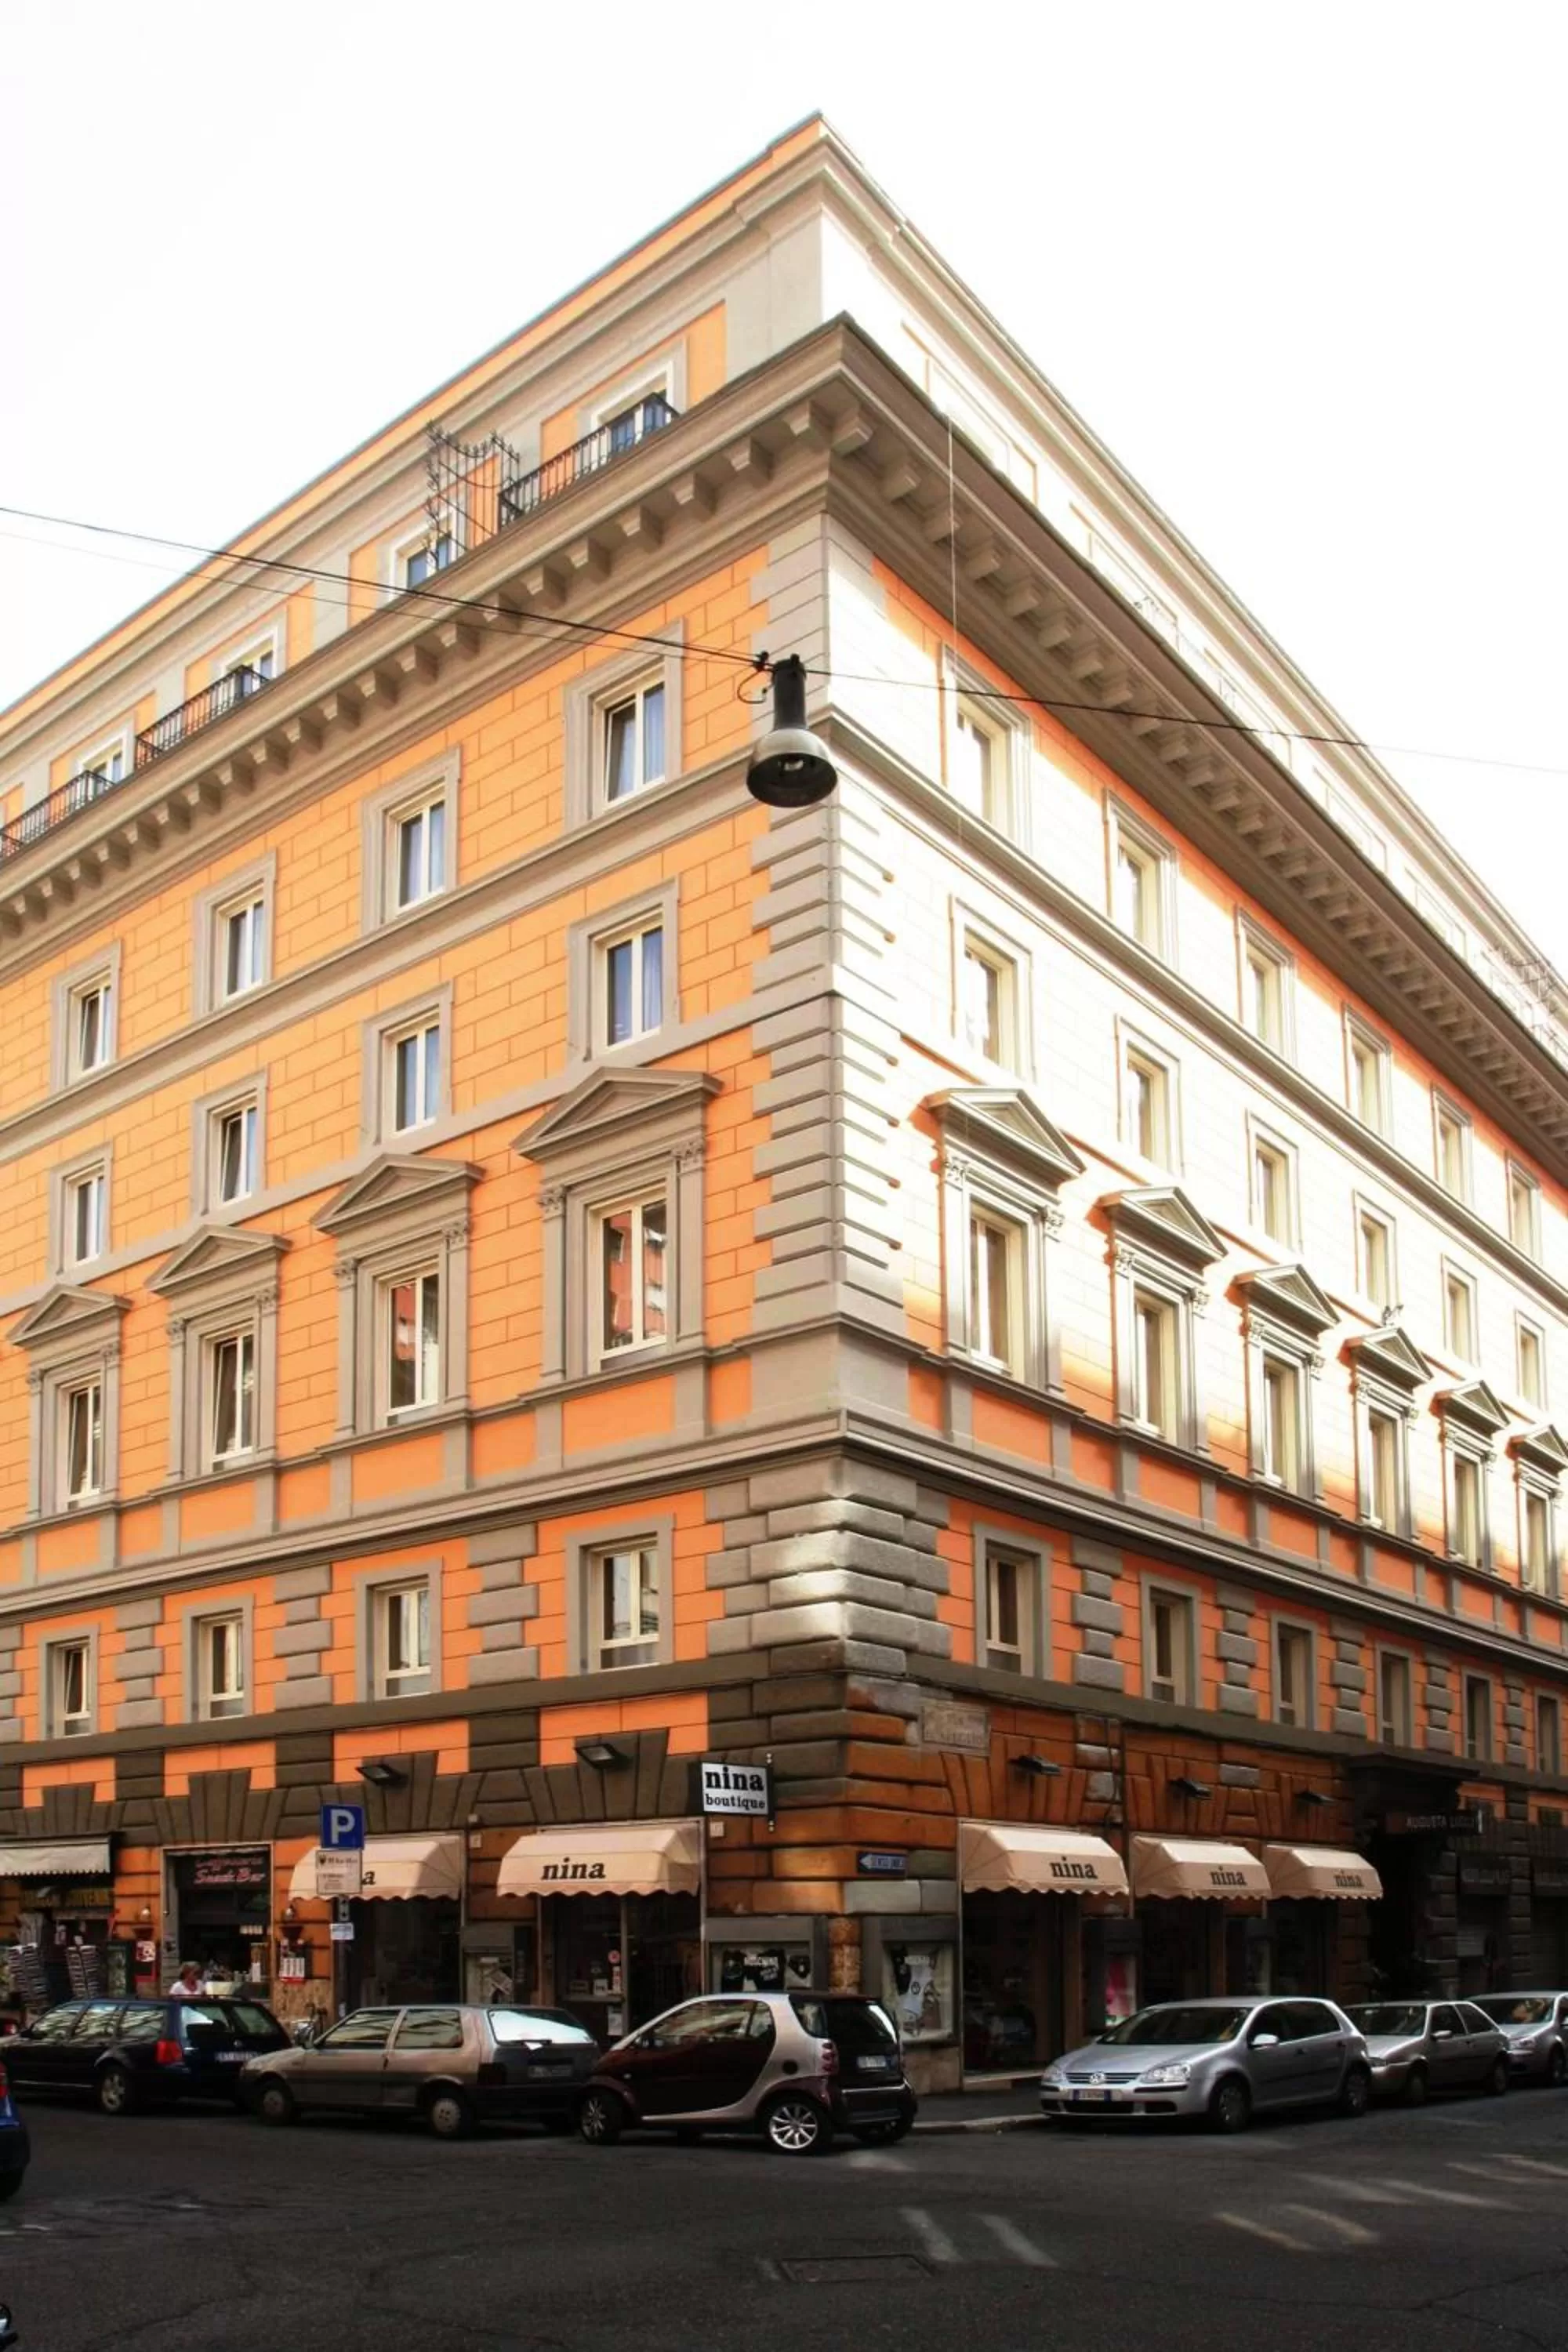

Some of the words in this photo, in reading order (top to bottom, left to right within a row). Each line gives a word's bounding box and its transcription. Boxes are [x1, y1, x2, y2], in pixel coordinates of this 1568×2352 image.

[705, 1766, 764, 1791] nina
[705, 1793, 766, 1811] boutique
[330, 1809, 355, 1845] P
[540, 1856, 607, 1881] nina
[1049, 1856, 1098, 1879] nina
[1209, 1865, 1247, 1886] nina
[1333, 1869, 1364, 1888] nina
